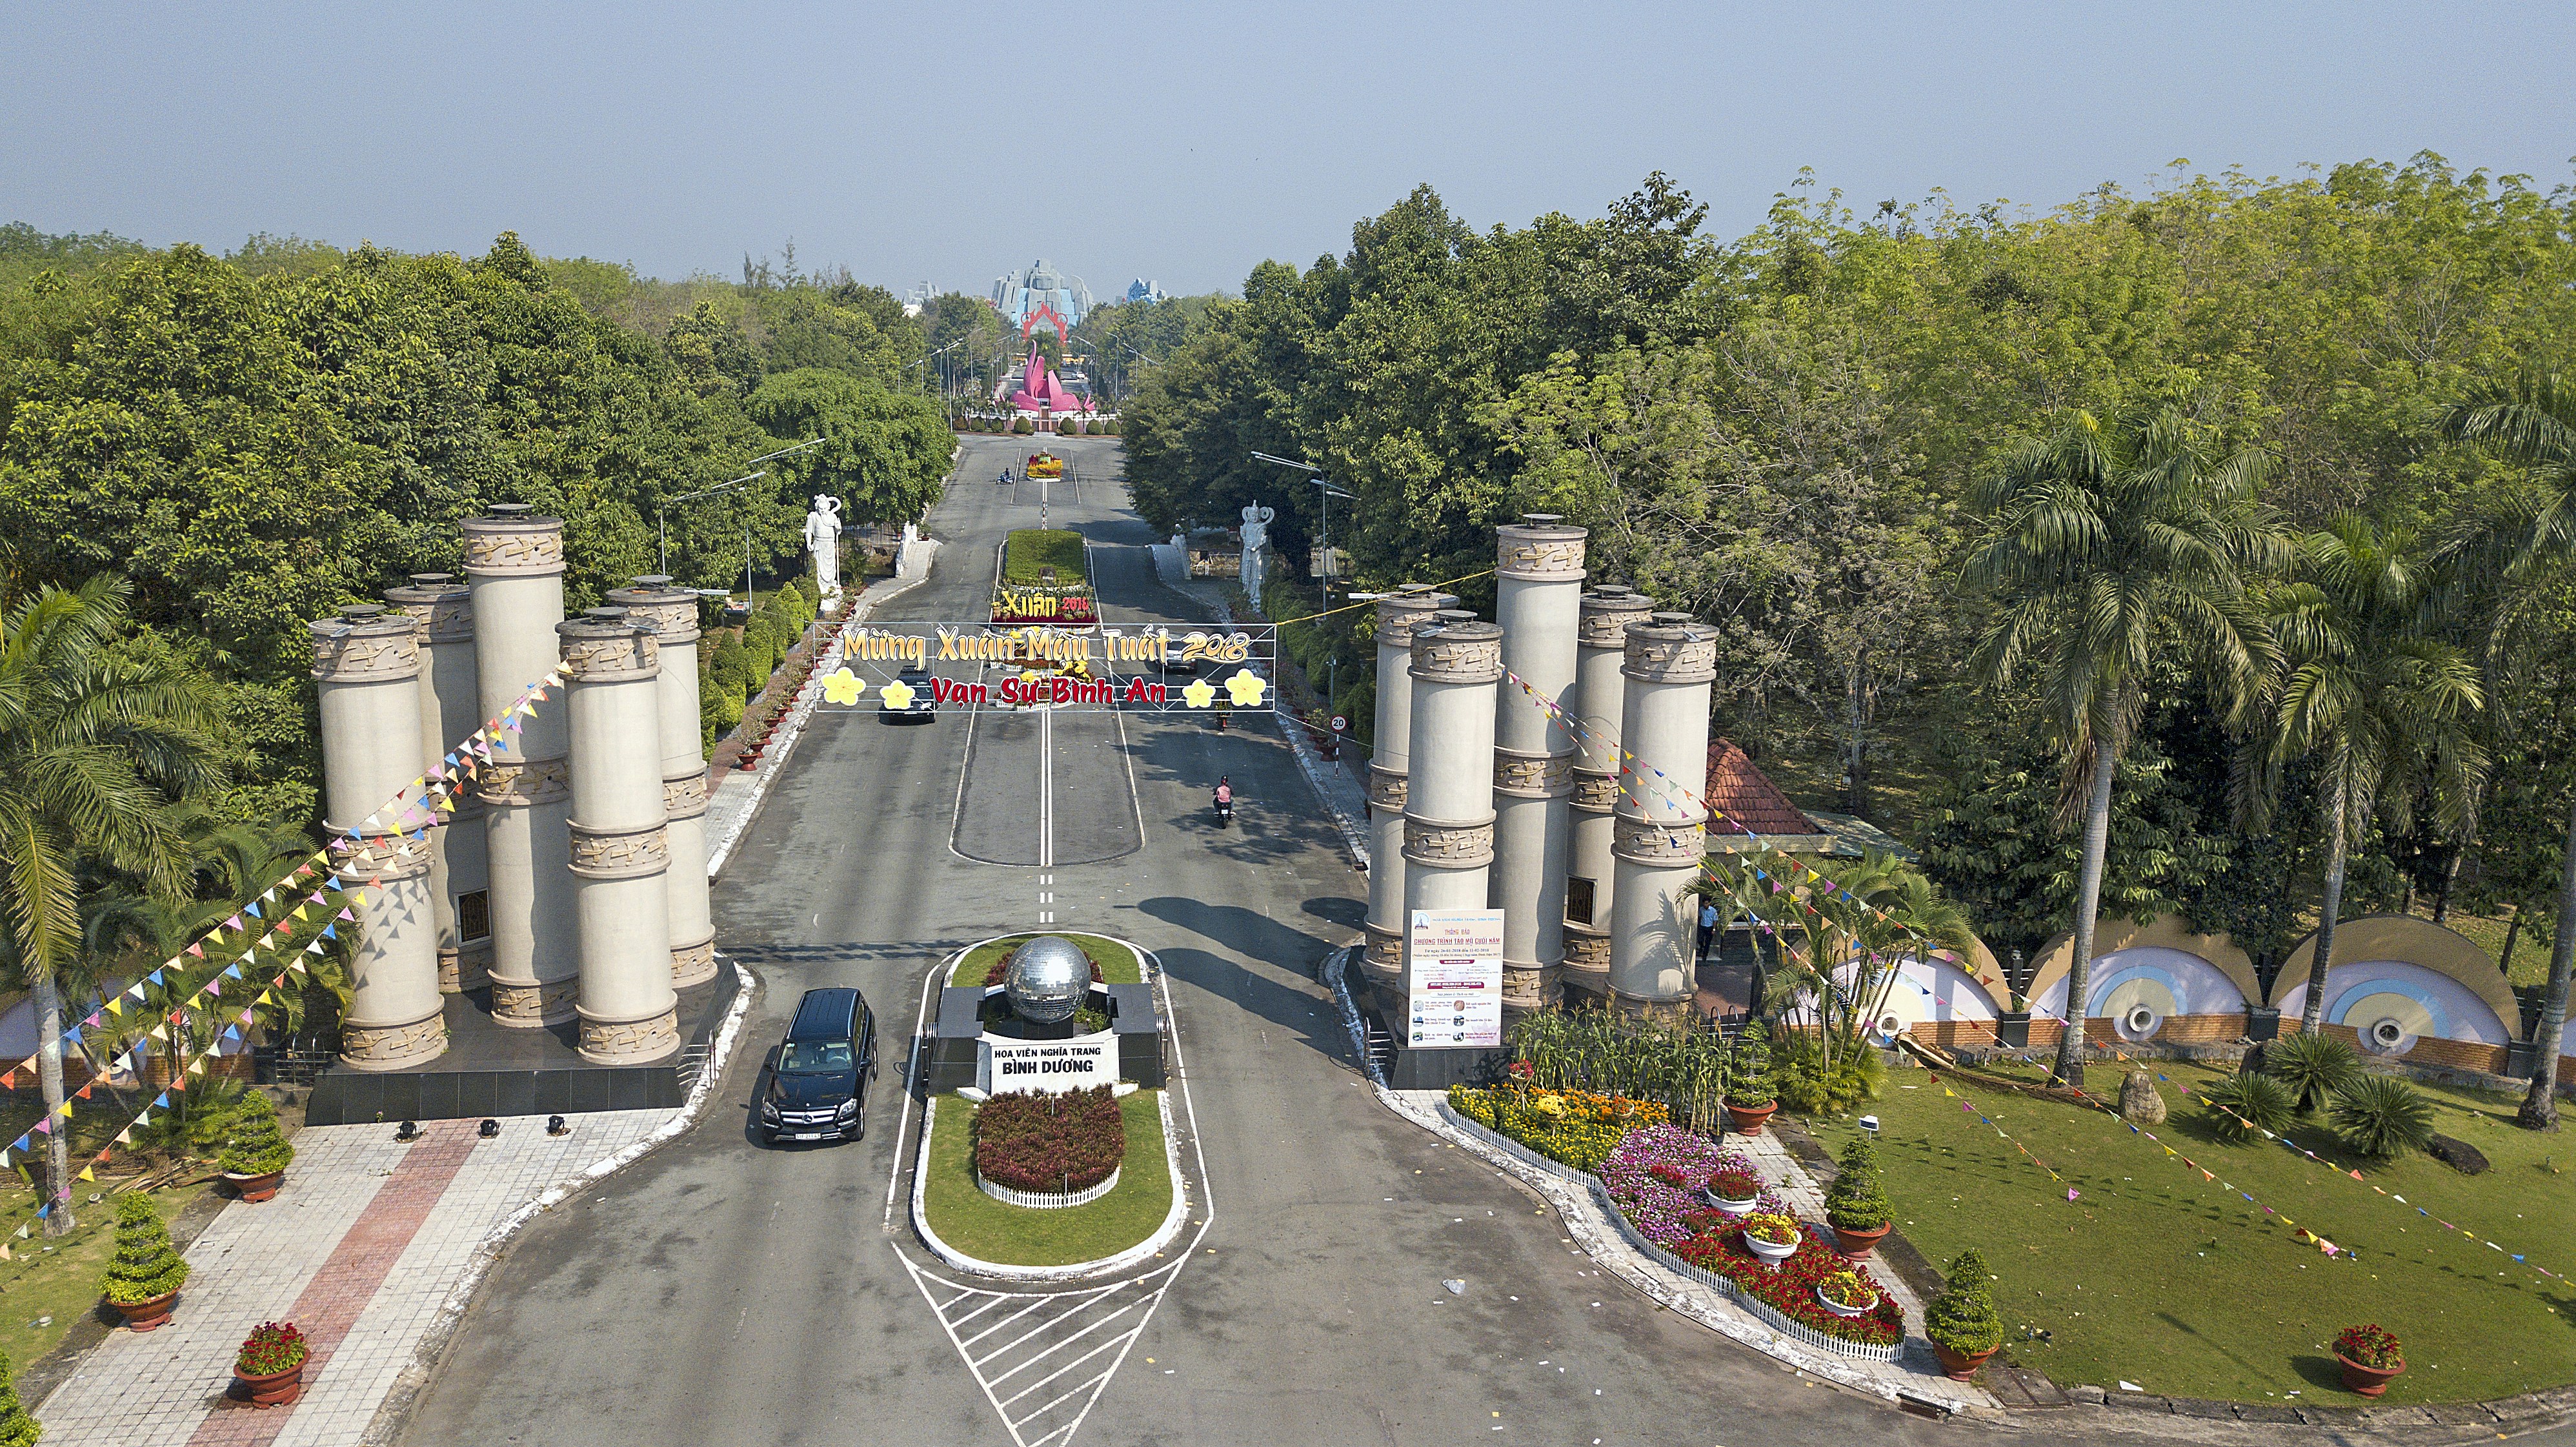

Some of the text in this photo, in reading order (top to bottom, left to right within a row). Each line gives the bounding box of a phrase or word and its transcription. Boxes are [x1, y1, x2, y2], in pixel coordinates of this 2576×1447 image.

[1063, 597, 1089, 611] 2018
[843, 624, 1250, 671] Mừng Xuân Mậu Tuất 2018
[929, 676, 1166, 709] Vạn Sự Bình An
[994, 1046, 1101, 1058] HOA VIÊN NGHĨA TRANG
[1002, 1058, 1093, 1075] BÌNH DƯƠNG
